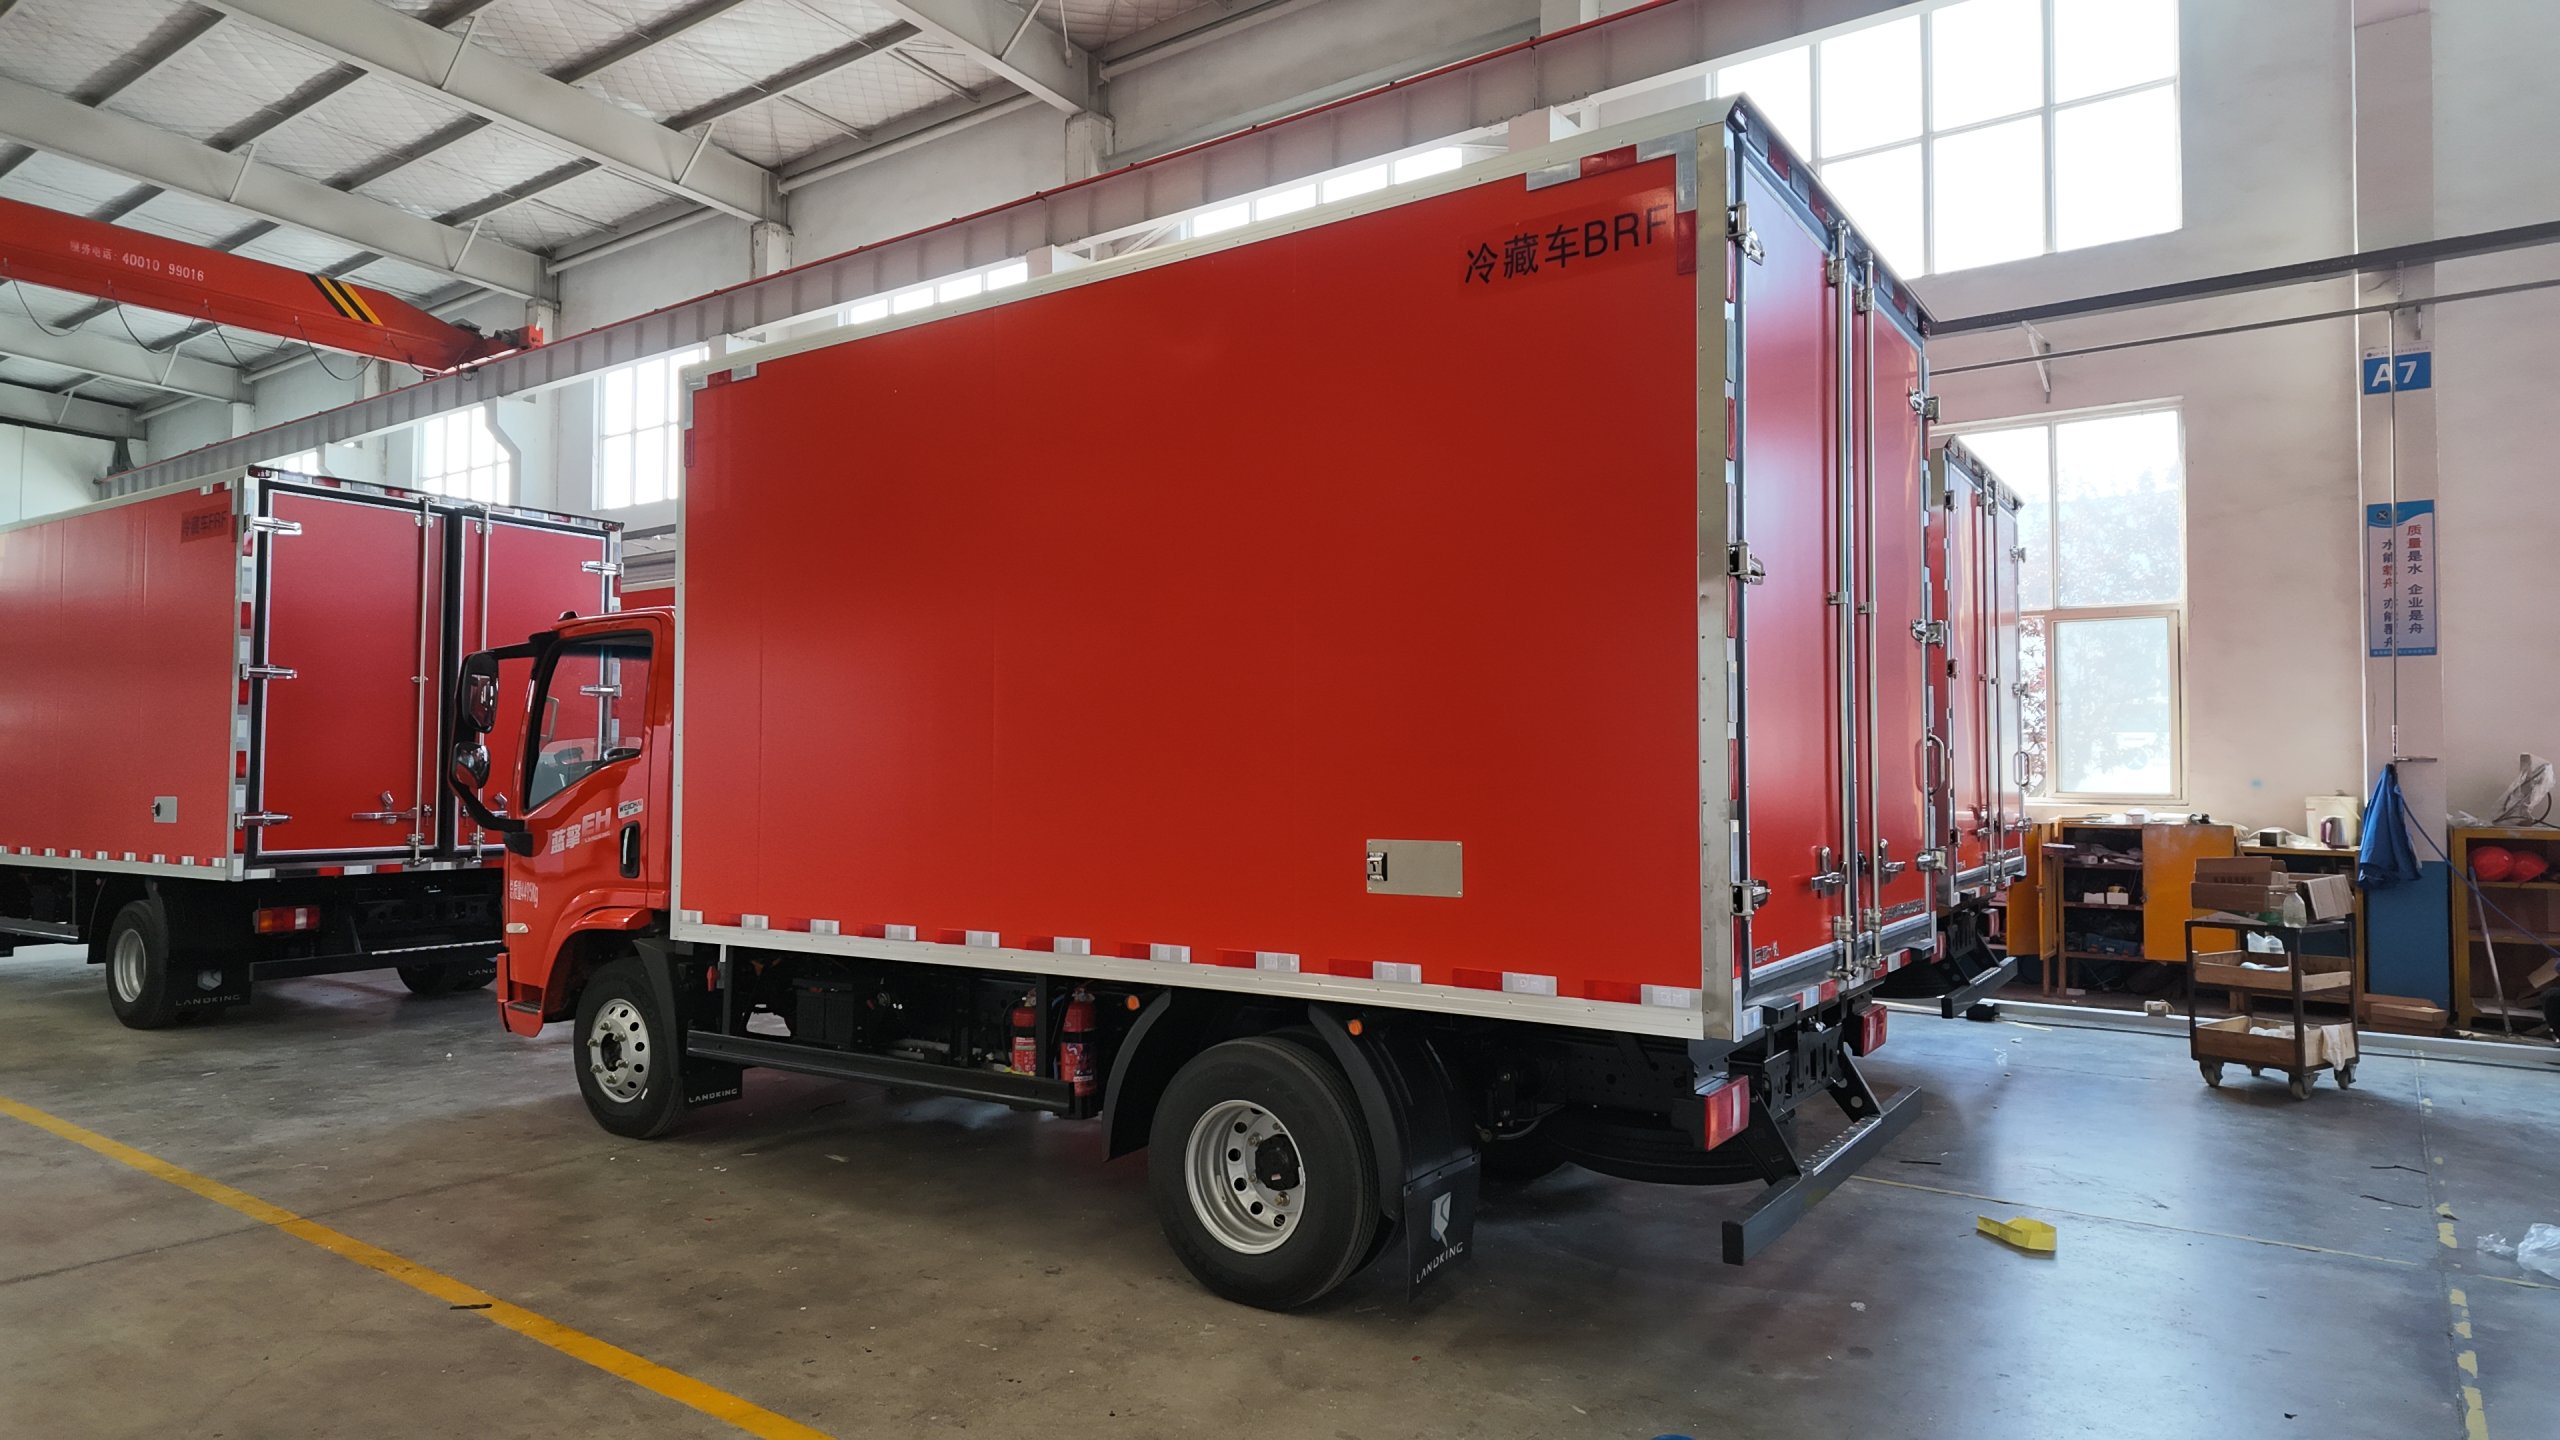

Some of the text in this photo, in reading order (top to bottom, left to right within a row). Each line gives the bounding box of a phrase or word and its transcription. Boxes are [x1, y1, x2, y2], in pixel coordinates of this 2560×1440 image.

[1465, 203, 1669, 284] 冷藏车BRF
[122, 252, 160, 272] 40010
[2371, 360, 2417, 387] A7
[2407, 524, 2425, 634] 质量是水 企业是舟
[581, 807, 612, 836] EH
[175, 994, 241, 1007] LANDKING
[688, 1087, 738, 1103] LANDKING
[1416, 1241, 1464, 1284] LANDKING
